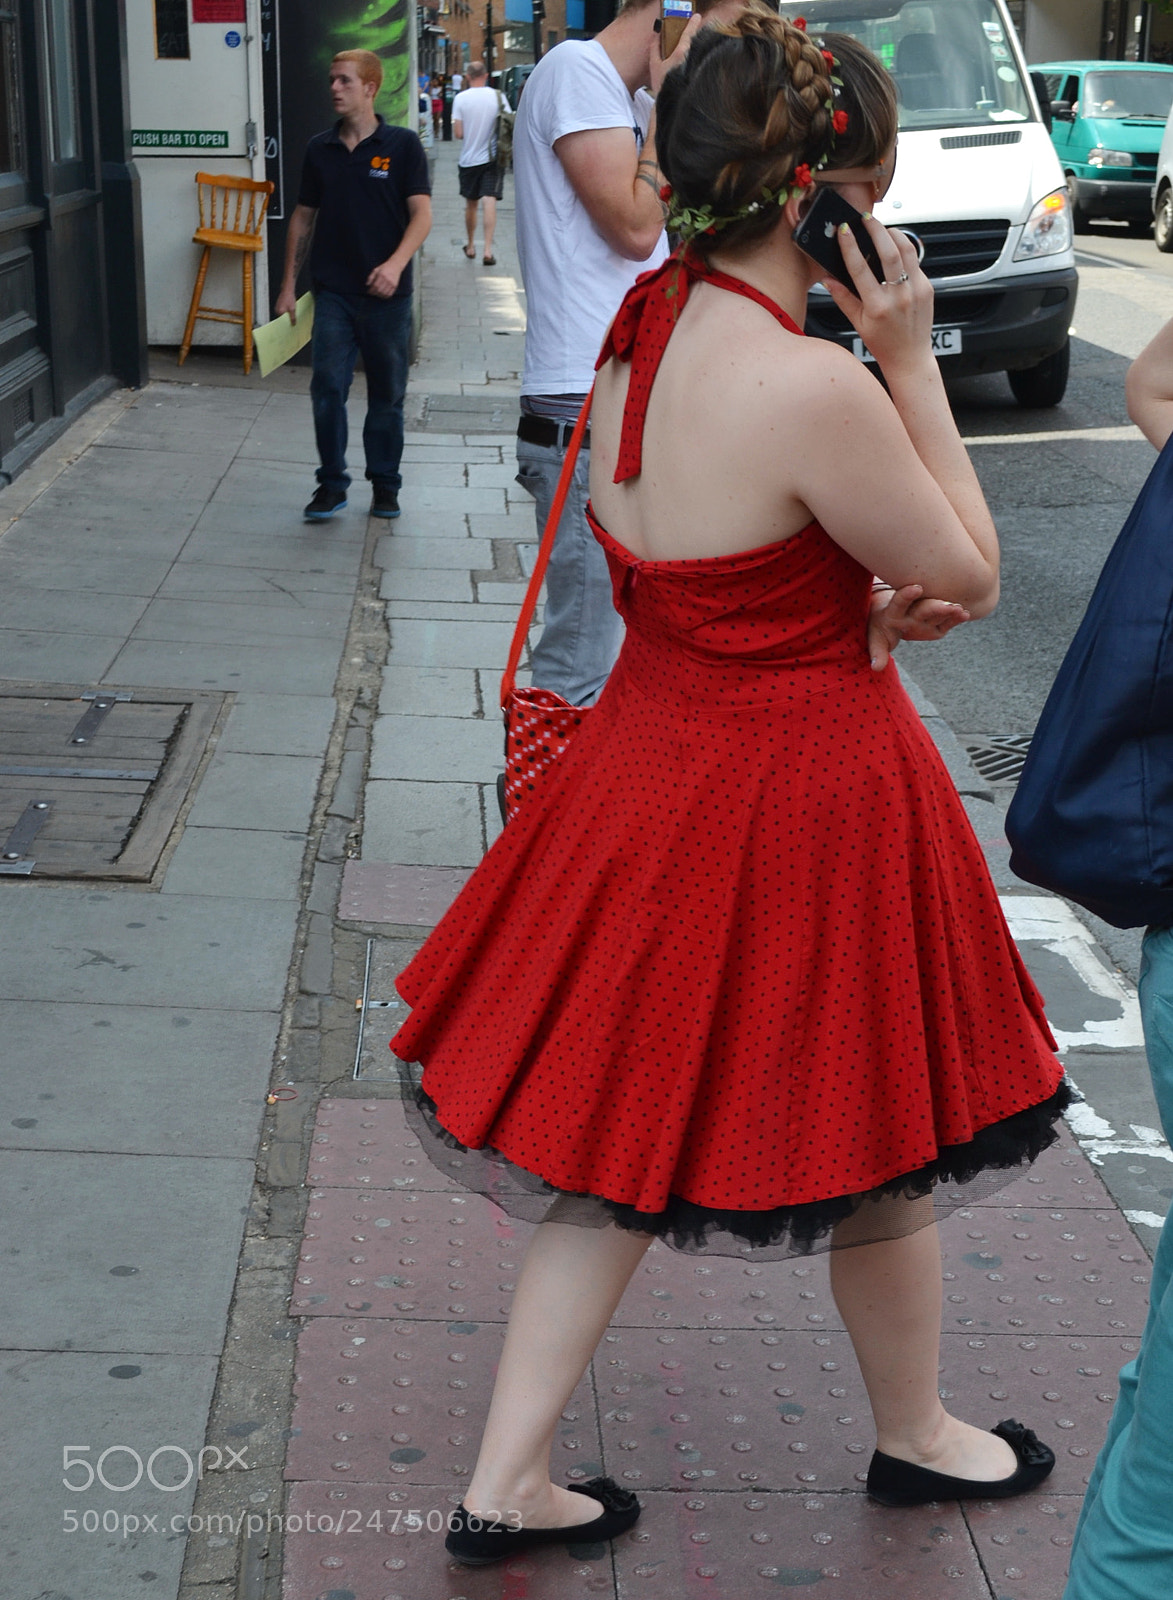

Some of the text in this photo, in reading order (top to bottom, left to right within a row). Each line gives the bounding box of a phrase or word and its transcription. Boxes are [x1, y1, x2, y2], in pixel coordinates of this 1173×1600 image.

[133, 133, 225, 146] PUSH BAR TO OPEN
